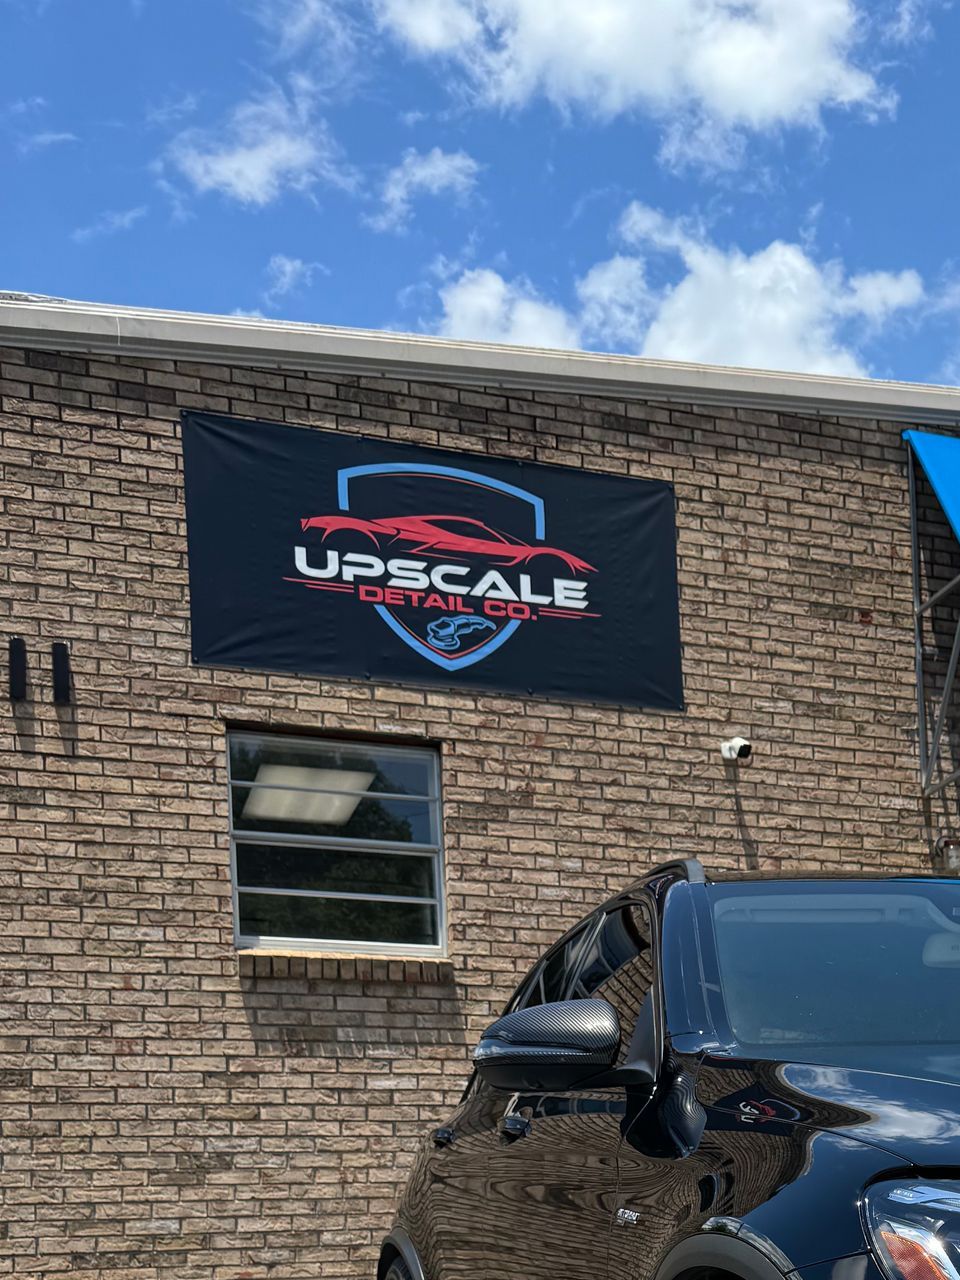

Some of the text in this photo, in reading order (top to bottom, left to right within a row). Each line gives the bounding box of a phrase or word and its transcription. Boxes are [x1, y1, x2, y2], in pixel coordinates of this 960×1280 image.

[294, 546, 589, 609] UPSCALE
[358, 584, 538, 621] DETAIL CO.
